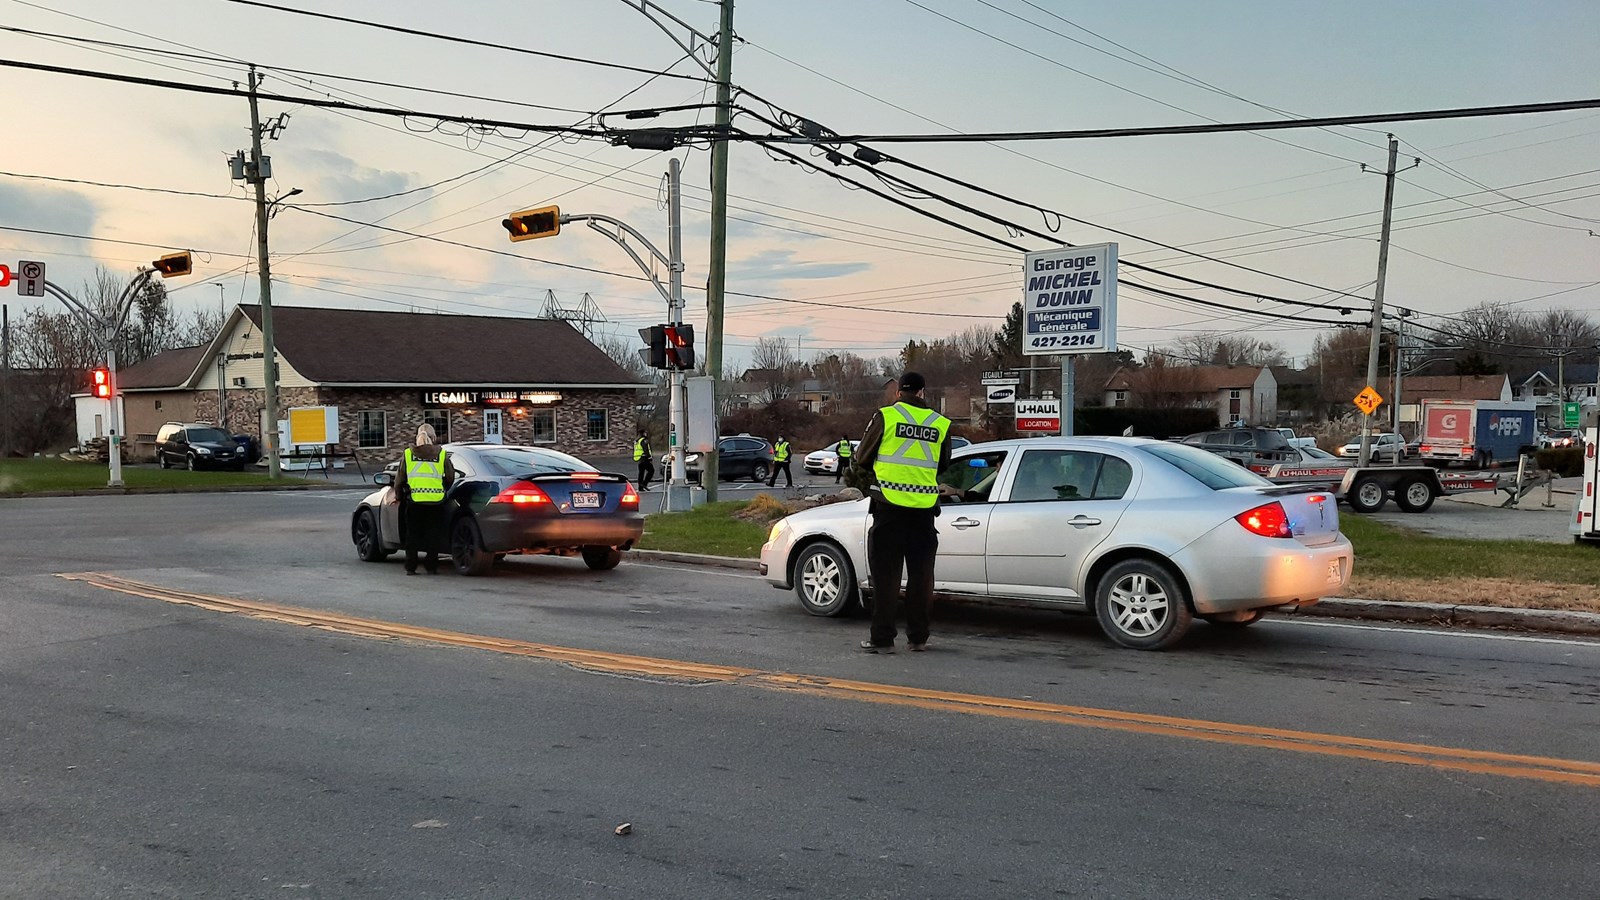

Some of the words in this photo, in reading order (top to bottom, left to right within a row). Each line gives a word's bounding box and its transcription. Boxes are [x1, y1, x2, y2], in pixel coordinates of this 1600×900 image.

[1034, 255, 1097, 272] Garage
[1028, 270, 1101, 292] MICHEL
[1036, 289, 1093, 308] DUNN
[1034, 311, 1093, 322] Mécanique
[1039, 321, 1088, 332] Générale
[1031, 335, 1096, 348] 427-2214
[982, 371, 1003, 379] LEGAULT
[425, 392, 478, 404] LEGAULT
[481, 391, 499, 399] AUDIO
[500, 391, 518, 399] VIDEO
[1017, 404, 1058, 414] U-HAUL
[1024, 420, 1052, 428] LOCATION
[898, 424, 938, 441] POLICE
[1282, 469, 1314, 477] U-HAUL
